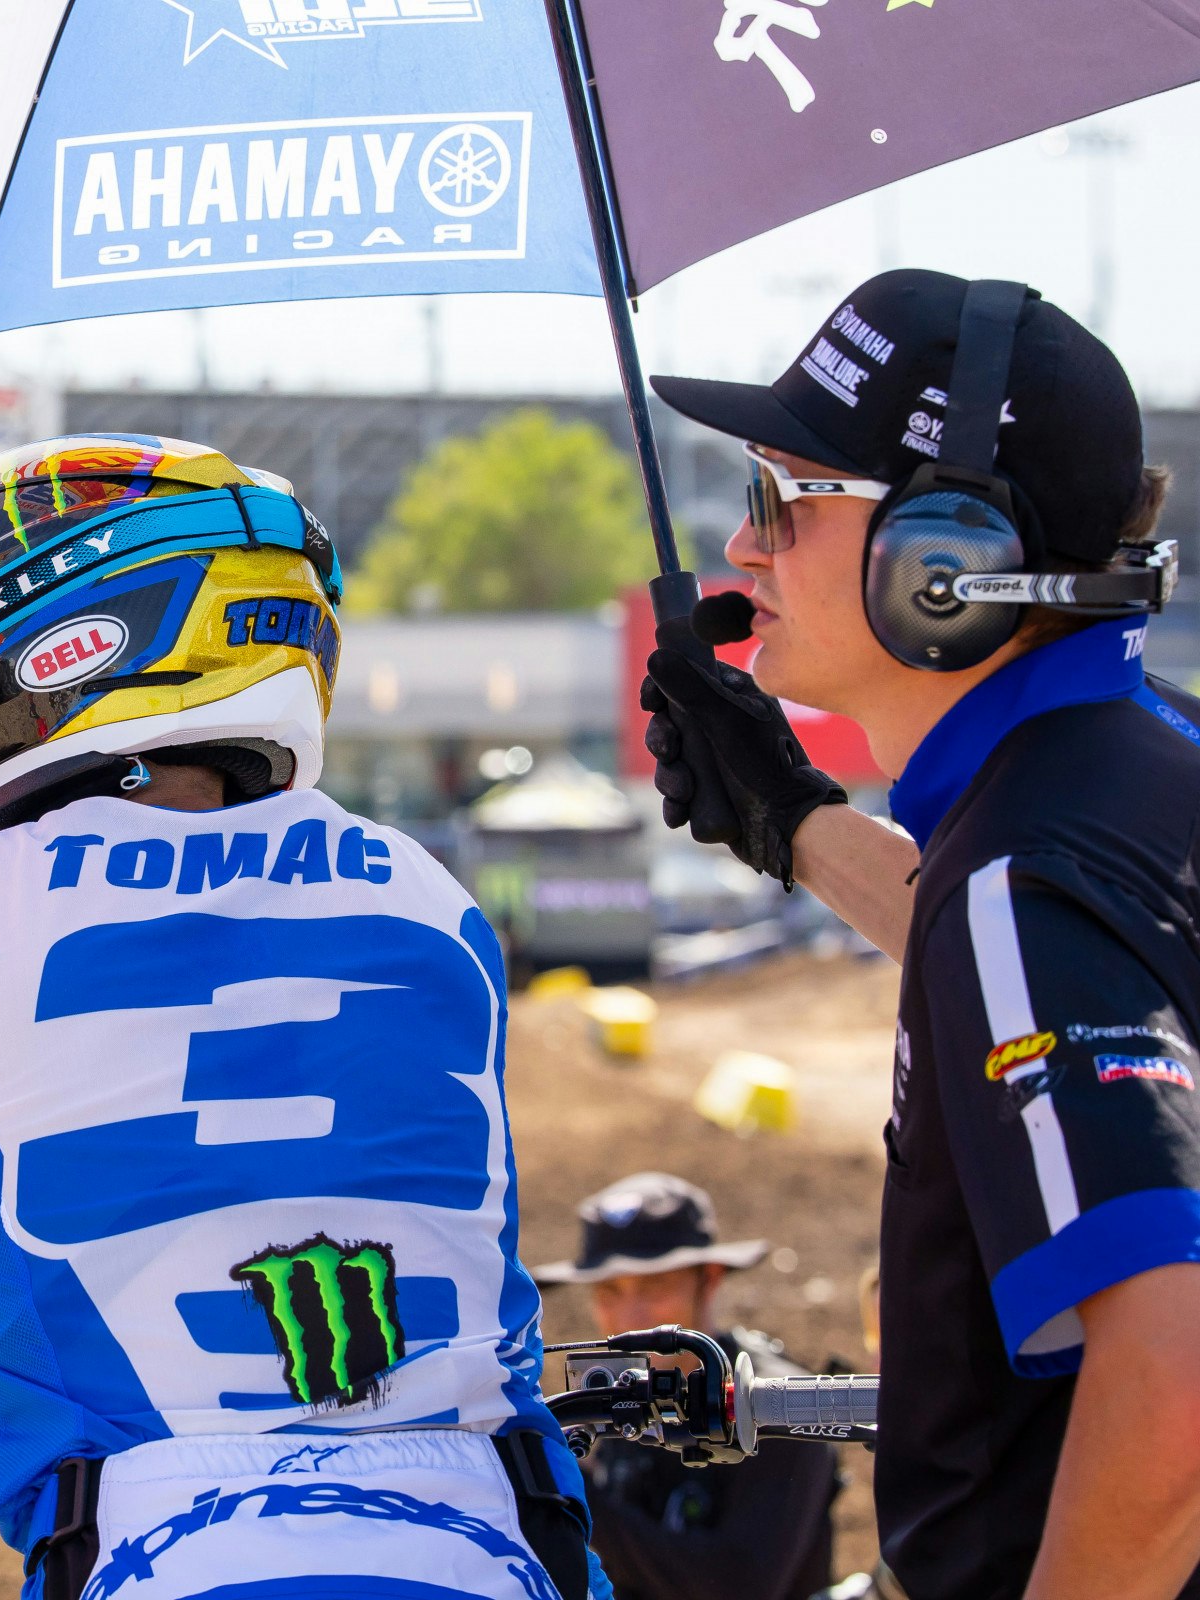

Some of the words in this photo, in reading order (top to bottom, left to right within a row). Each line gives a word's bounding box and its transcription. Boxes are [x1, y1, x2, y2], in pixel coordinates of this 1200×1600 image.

[840, 311, 896, 365] YAMAHA
[30, 627, 114, 682] BELL
[44, 818, 392, 895] TOMAC
[17, 911, 493, 1246] 3
[790, 1424, 851, 1438] ARC
